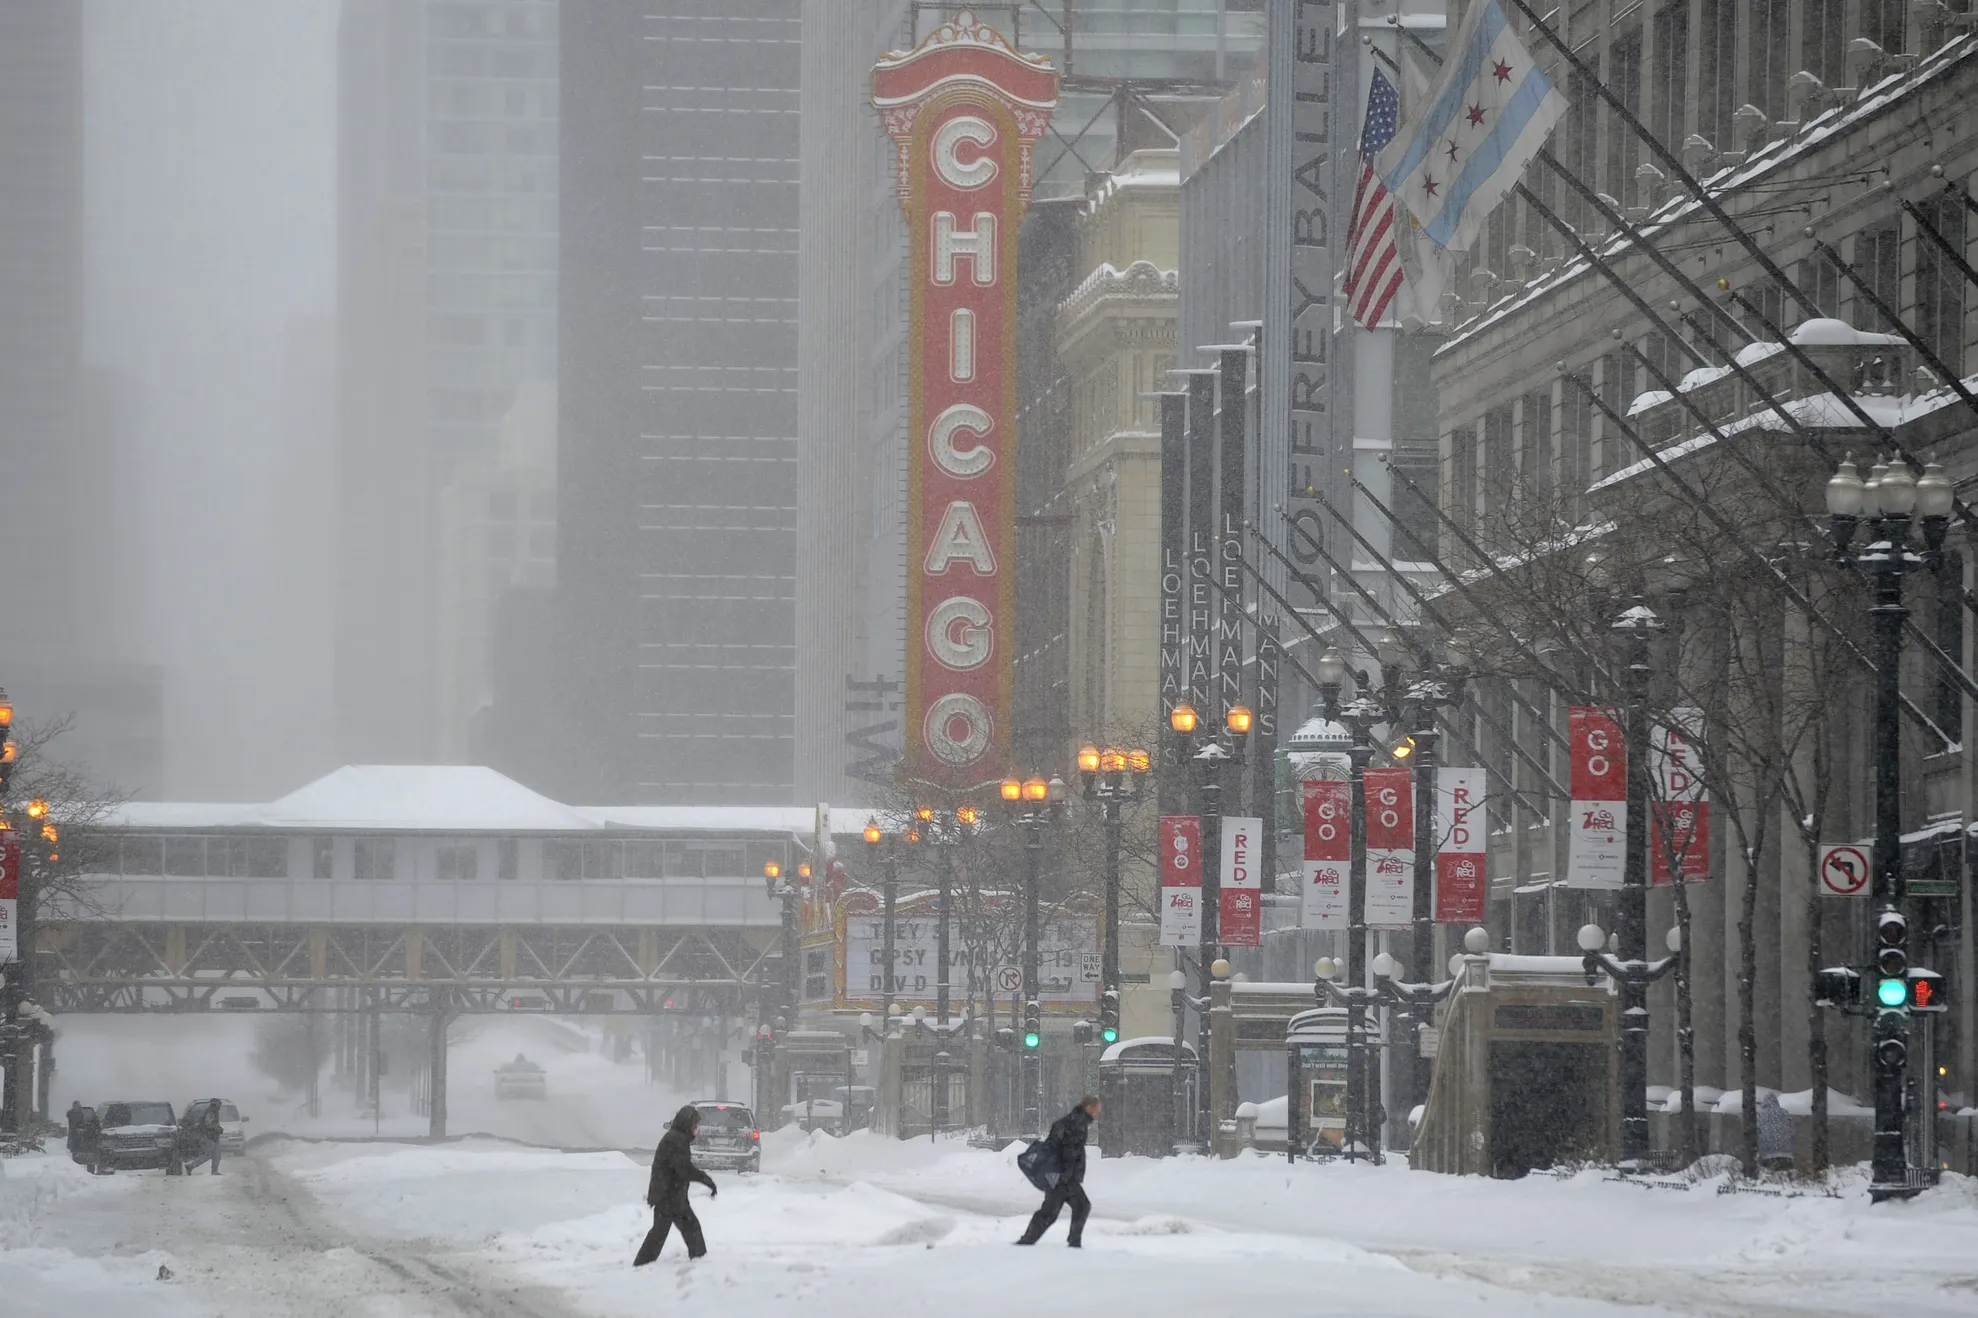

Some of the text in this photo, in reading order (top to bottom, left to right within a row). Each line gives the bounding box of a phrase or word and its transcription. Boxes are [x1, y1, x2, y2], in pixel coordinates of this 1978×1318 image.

[923, 115, 998, 766] CHICAGO
[1290, 274, 1326, 605] JOFFREY
[1588, 730, 1609, 776] GO
[1318, 803, 1336, 841] GO
[1380, 788, 1399, 828] GO
[1454, 787, 1470, 845] RED
[1233, 834, 1248, 882] RED
